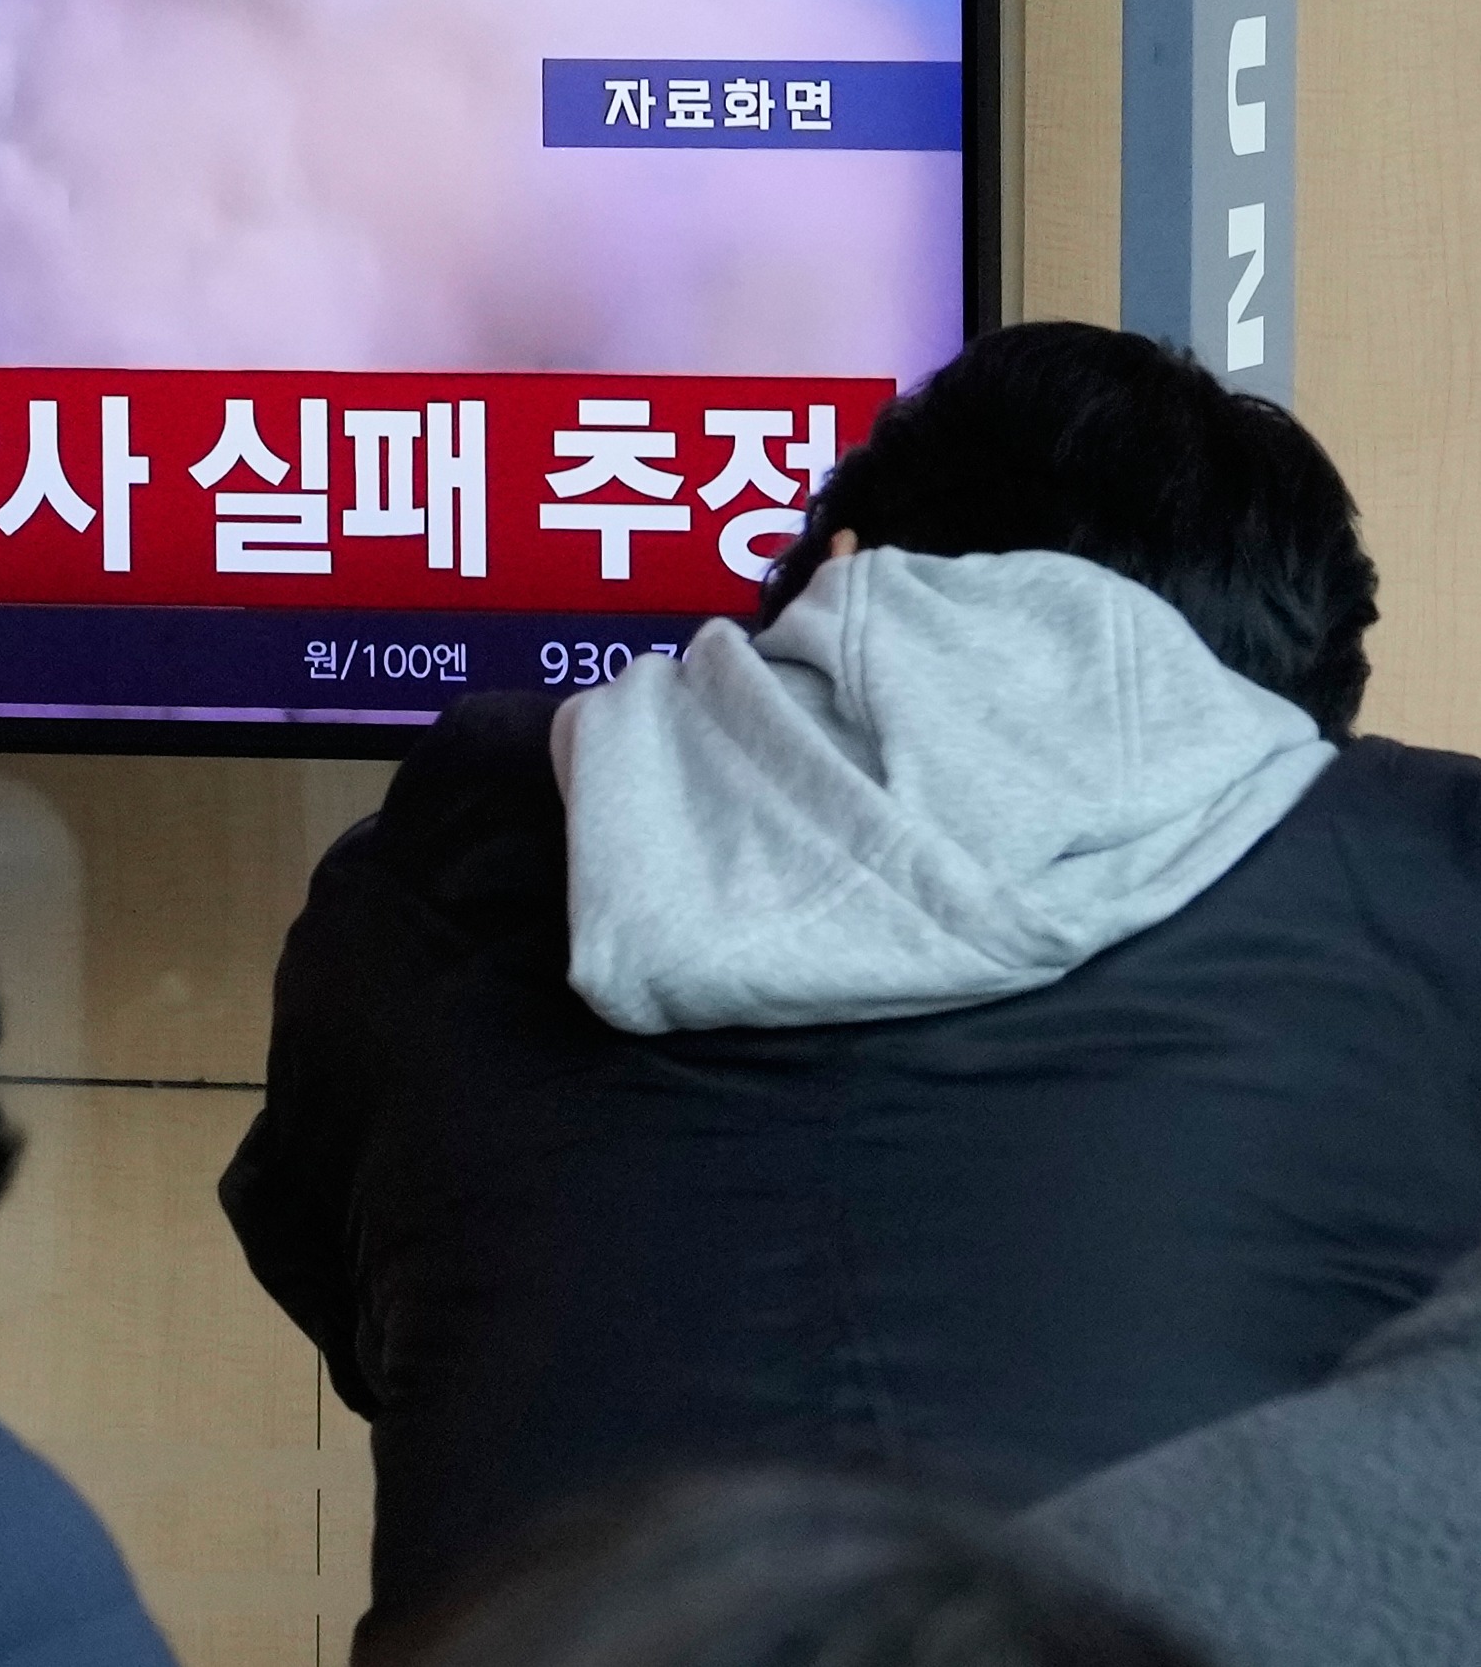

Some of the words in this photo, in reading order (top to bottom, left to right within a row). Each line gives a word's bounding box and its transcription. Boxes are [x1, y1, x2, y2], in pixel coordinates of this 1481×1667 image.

[604, 78, 833, 131] 자료화면
[187, 398, 488, 578] 실패
[539, 399, 837, 584] 추정
